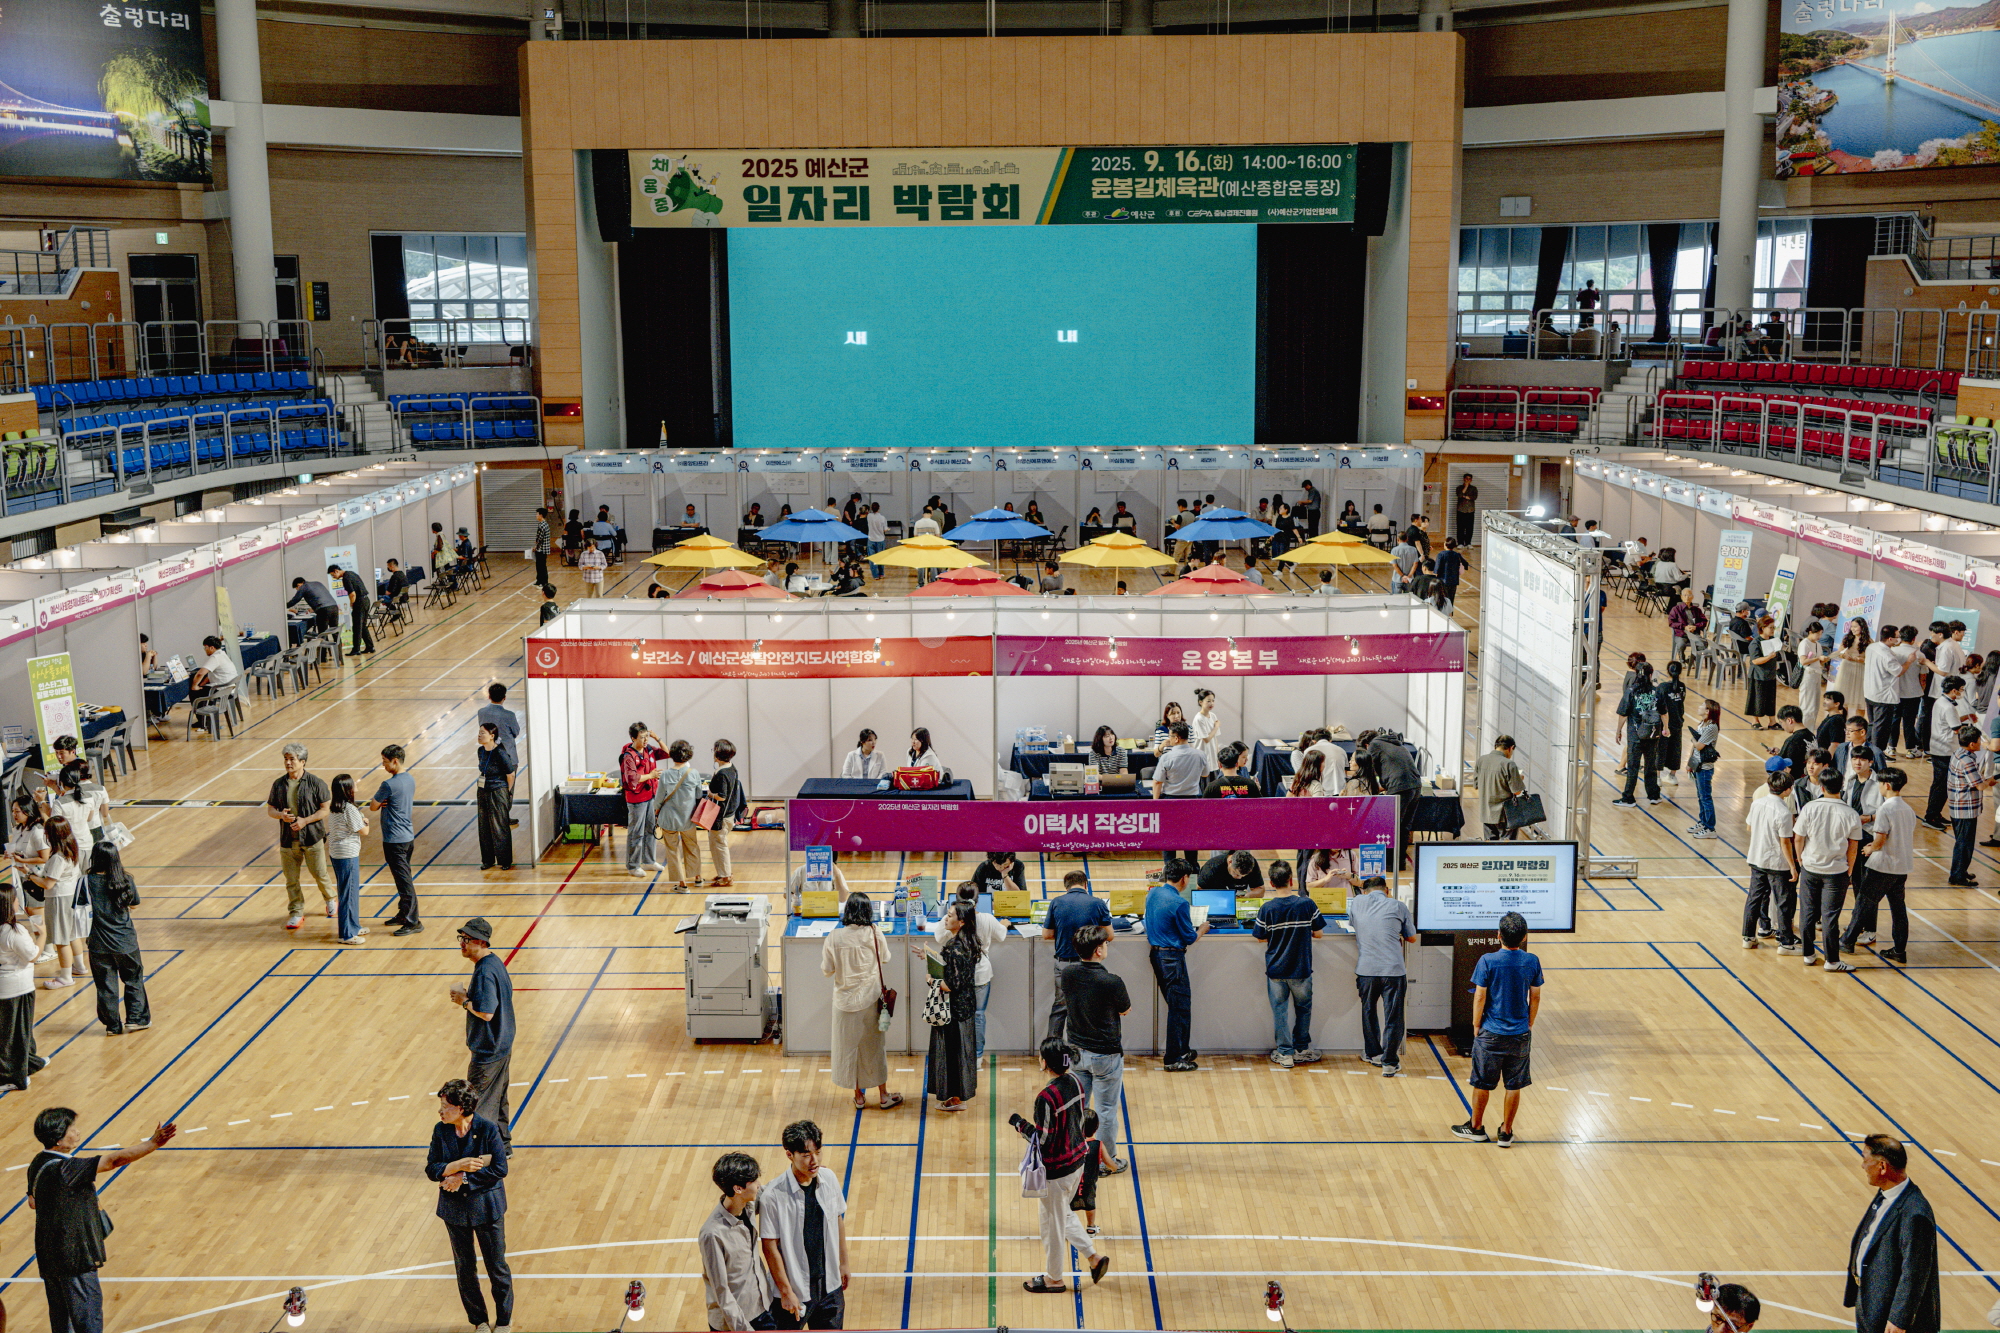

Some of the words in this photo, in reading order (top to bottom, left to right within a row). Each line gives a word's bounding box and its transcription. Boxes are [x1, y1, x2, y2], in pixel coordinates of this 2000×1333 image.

[100, 4, 190, 30] 출렁다리
[652, 158, 669, 172] 채
[742, 159, 798, 178] 2025
[805, 158, 869, 178] 예산군
[1091, 156, 1136, 171] 2025.
[1144, 150, 1164, 172] 9.
[1243, 155, 1342, 170] 14:00~16:00
[1091, 177, 1341, 199] 윤봉길체육관(예산종합운동장)
[743, 185, 870, 222] 일자리
[893, 183, 1020, 221] 박람회
[1130, 210, 1156, 219] 예산군
[843, 331, 867, 345] 새
[1057, 330, 1078, 343] 내
[1721, 544, 1749, 558] 참여자
[543, 652, 551, 662] 5
[642, 651, 684, 665] 보건소
[878, 803, 900, 811] 2025년
[901, 803, 920, 811] 예산군
[921, 803, 940, 811] 일자리
[940, 803, 959, 811] 박람회
[1024, 813, 1088, 835] 이력서
[1095, 812, 1160, 834] 작성대
[1482, 860, 1514, 871] 일자리
[1517, 860, 1549, 870] 박람회
